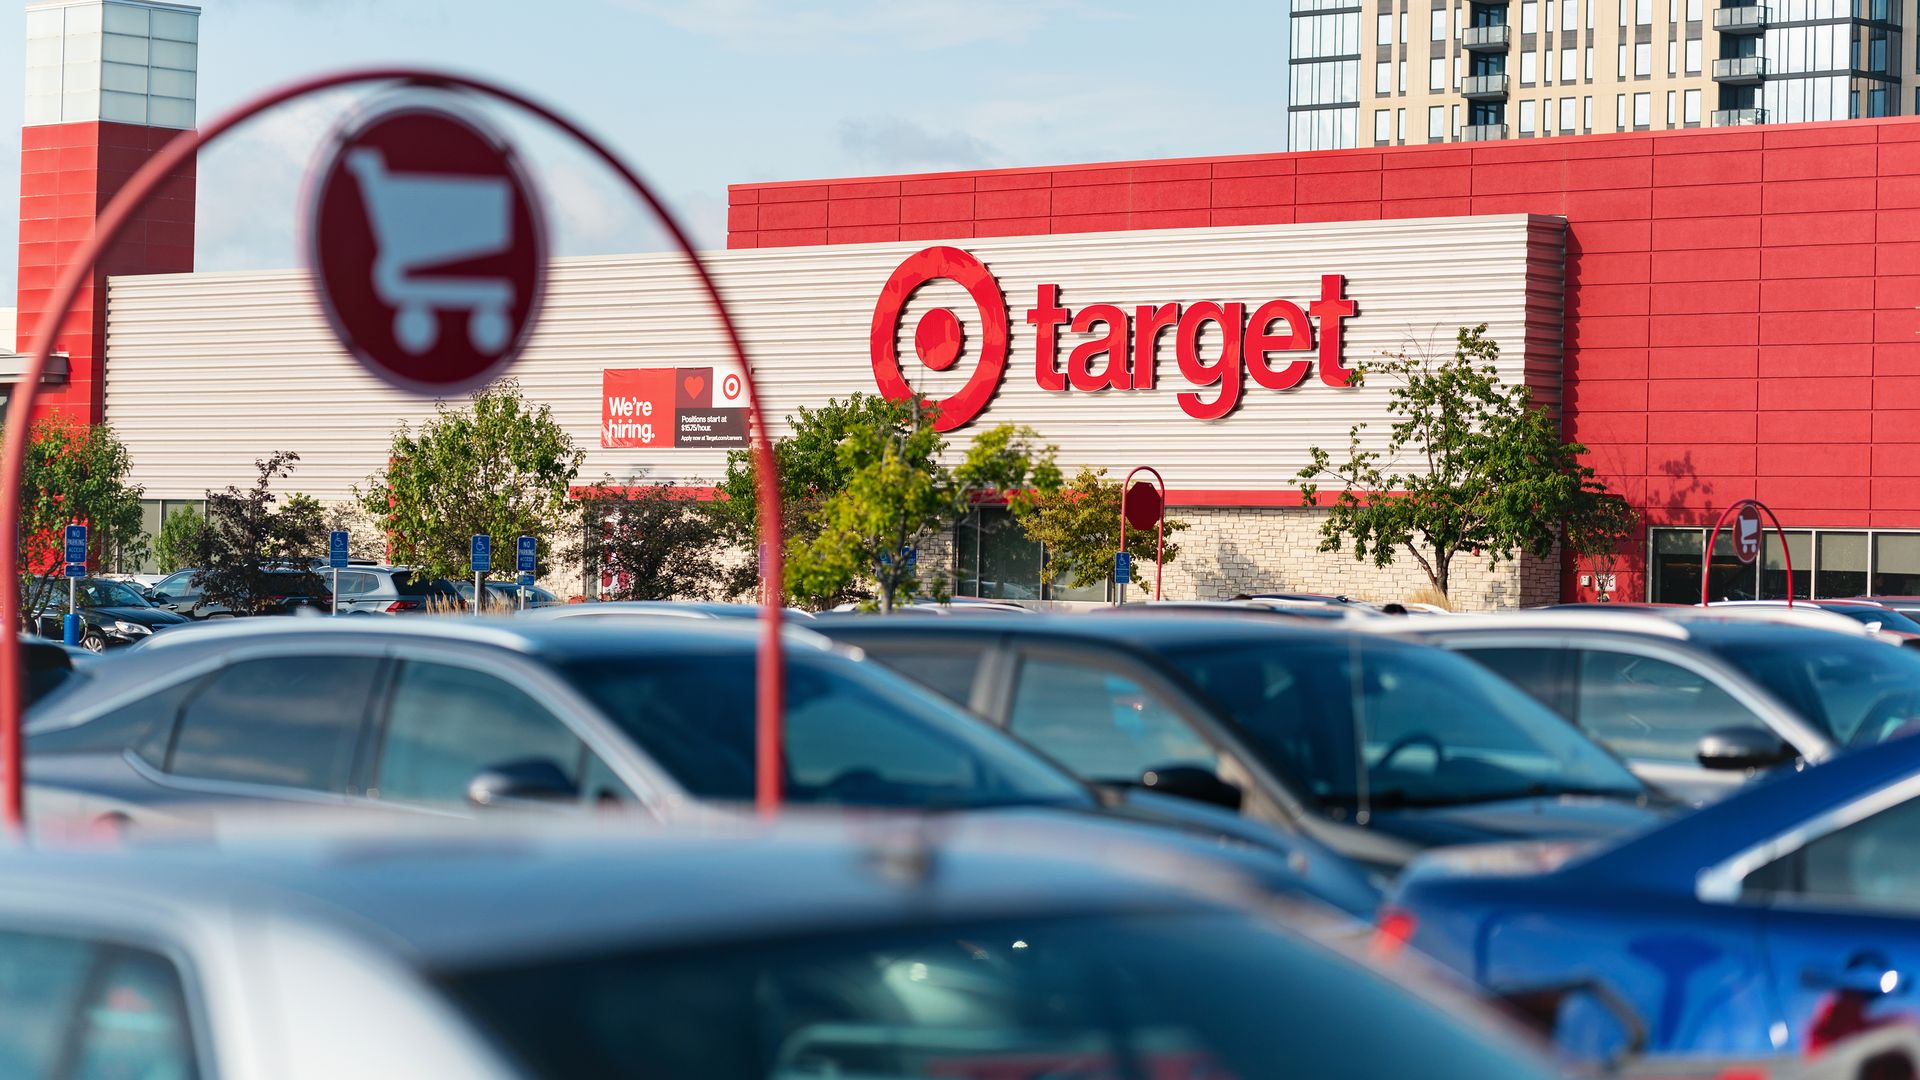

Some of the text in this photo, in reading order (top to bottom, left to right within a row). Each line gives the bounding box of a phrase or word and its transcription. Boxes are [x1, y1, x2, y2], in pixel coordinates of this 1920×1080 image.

[1027, 274, 1358, 420] target
[608, 396, 653, 416] We're
[681, 415, 706, 423] Positions
[707, 415, 720, 423] start
[608, 418, 656, 443] hiring.
[71, 530, 81, 538] NO
[67, 538, 85, 546] PARKING
